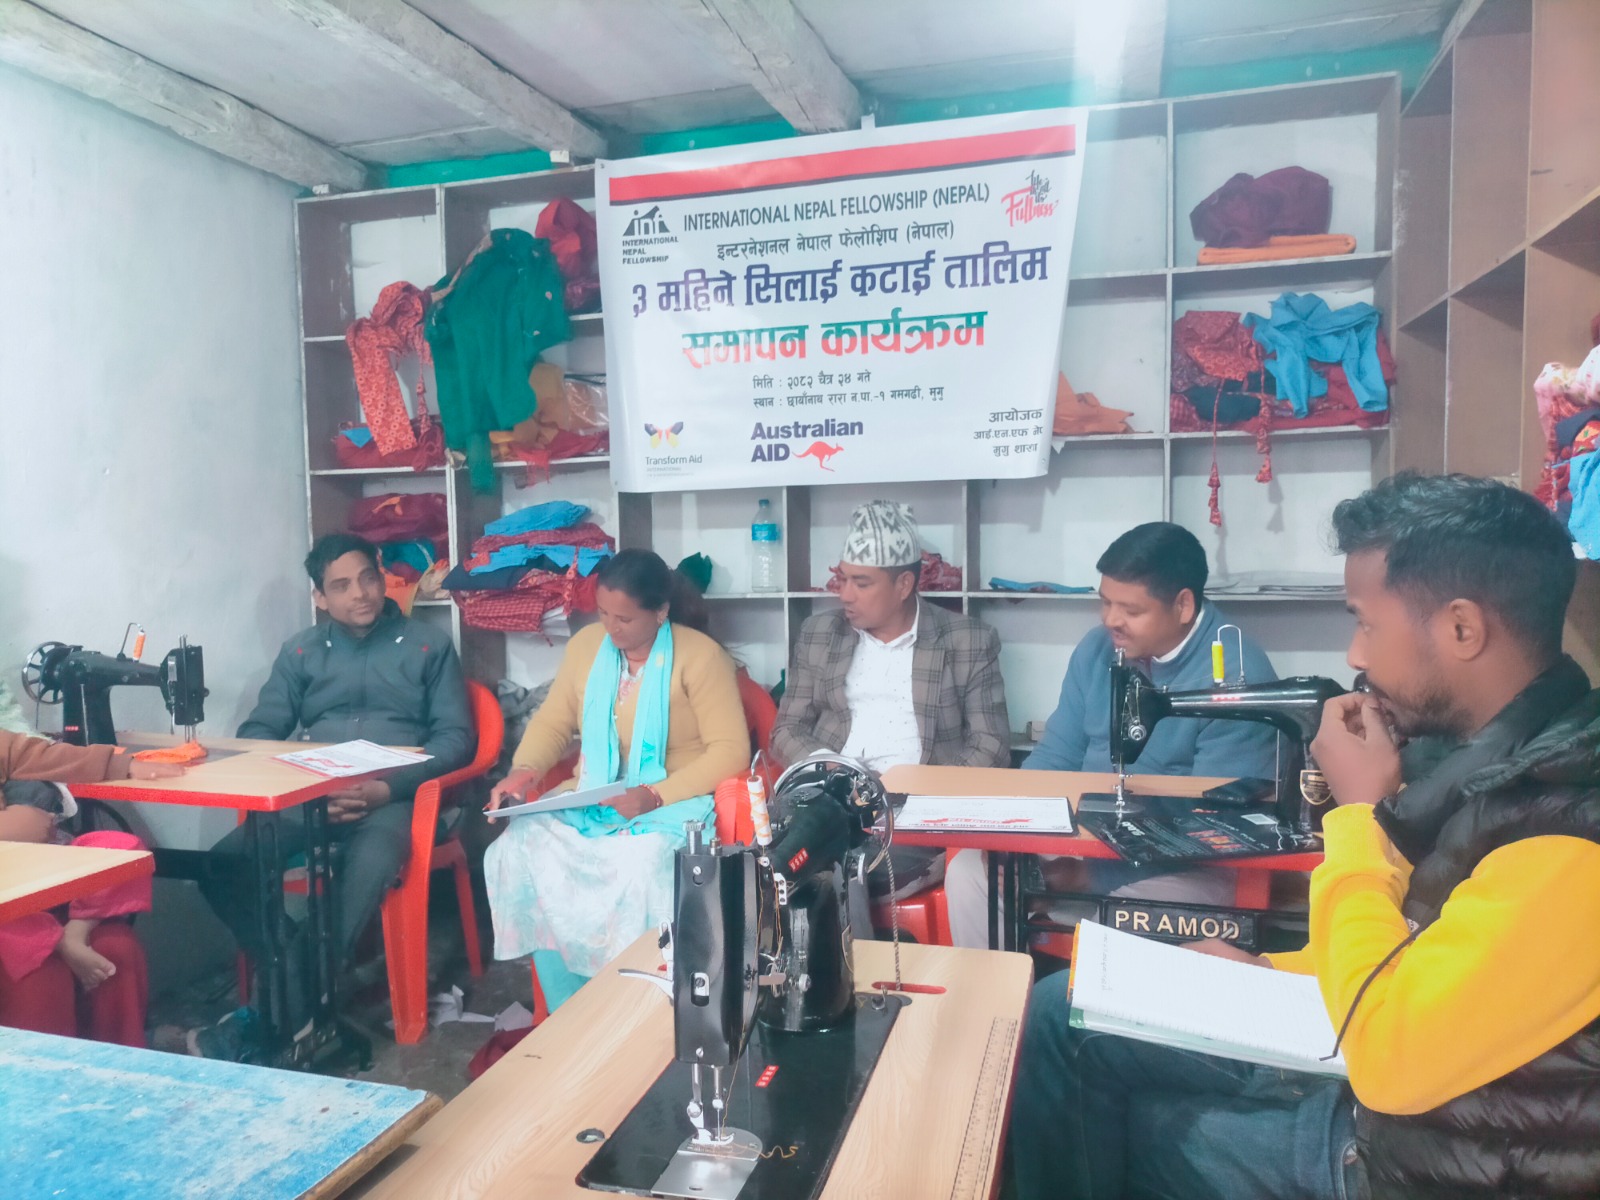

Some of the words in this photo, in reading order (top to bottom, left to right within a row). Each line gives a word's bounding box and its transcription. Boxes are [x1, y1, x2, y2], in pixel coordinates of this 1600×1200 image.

[684, 204, 790, 232] INTERNATIONAL
[794, 199, 837, 221] NEPAL
[841, 189, 928, 216] FELLOWSHIP
[933, 183, 990, 208] (NEPAL)
[622, 236, 679, 247] INTERNATIONAL
[717, 237, 791, 260] इन्टरनेशनल
[796, 233, 833, 251] नेपाल
[839, 224, 899, 248] फेलोशिप
[907, 220, 954, 244] (नेपाल)
[622, 248, 647, 256] NEPAL
[622, 255, 670, 265] FELLOWSHIP
[632, 284, 647, 318] ३
[657, 268, 737, 312] महिने
[744, 259, 843, 306] सिलाई
[850, 250, 936, 297] कटाई
[943, 240, 1052, 289] तालिम
[682, 325, 809, 369] समापन
[821, 307, 988, 357] कार्यक्रम
[752, 375, 774, 389] मिति
[787, 376, 813, 390] २०८२
[817, 370, 834, 385] चैत्र
[838, 373, 851, 387] २४
[857, 369, 871, 383] गते
[753, 397, 774, 408] स्थान
[988, 407, 1043, 423] आयोजक
[751, 418, 864, 441] Australian
[645, 455, 688, 466] Transform
[689, 454, 703, 464] Aid
[751, 443, 790, 463] AID
[993, 445, 1010, 457] मुगु
[1115, 910, 1241, 940] PRAMOD
